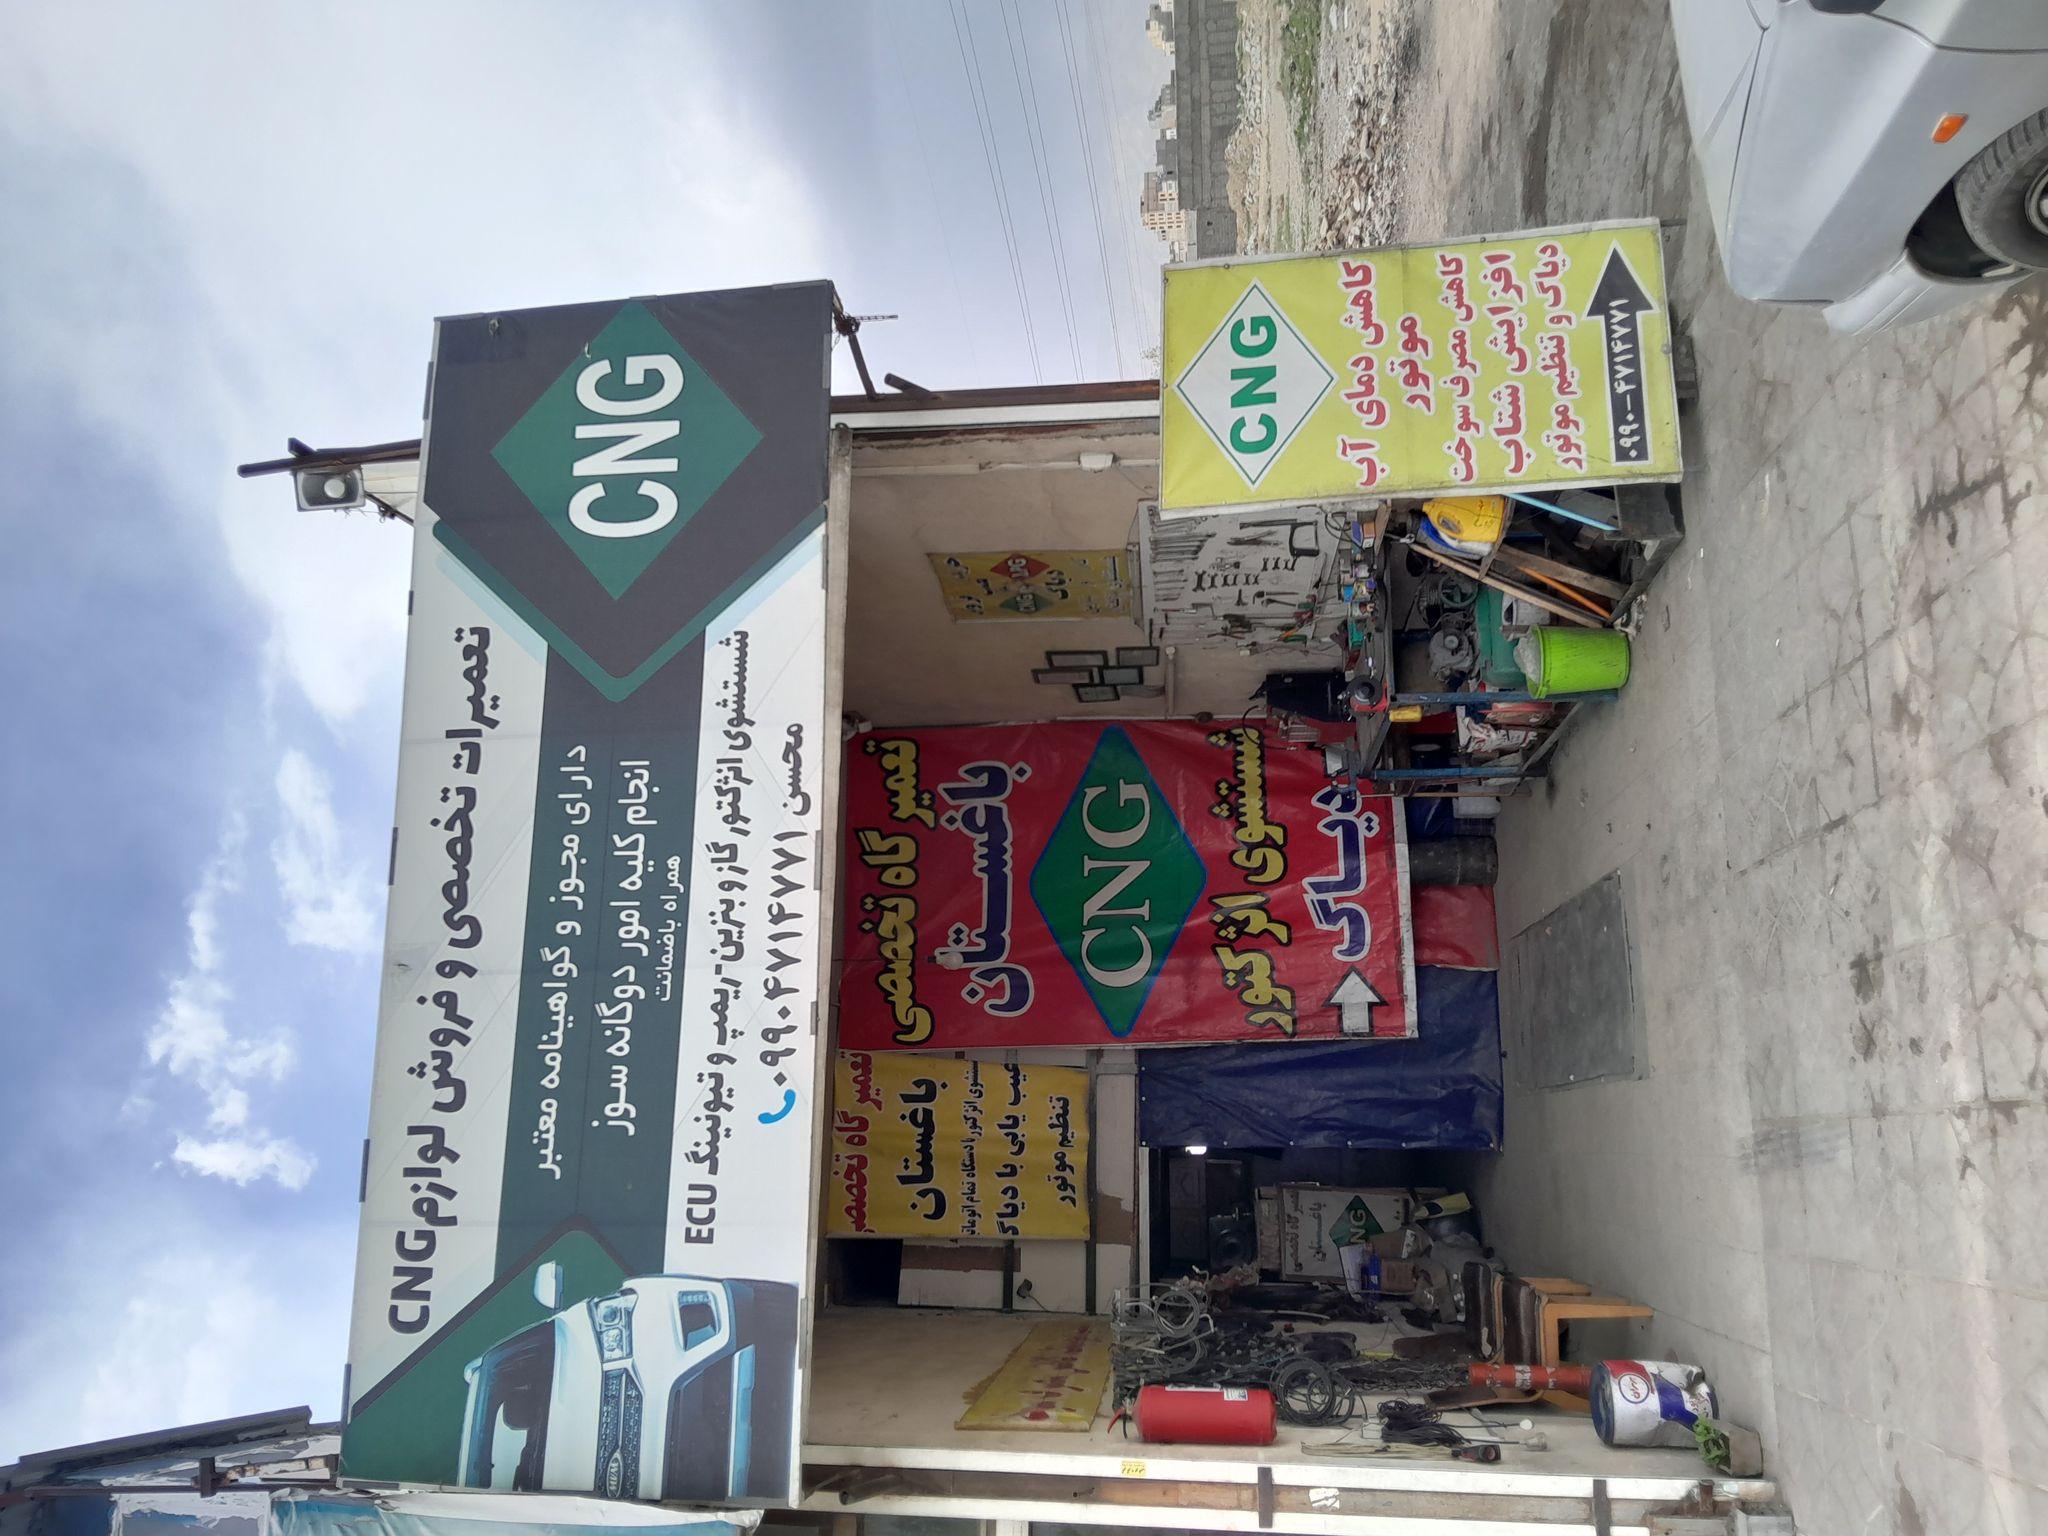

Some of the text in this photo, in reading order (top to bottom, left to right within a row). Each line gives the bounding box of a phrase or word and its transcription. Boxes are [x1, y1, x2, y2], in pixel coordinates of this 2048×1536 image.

[1229, 314, 1278, 455] CNG
[1341, 261, 1386, 486] کاهش دمای آب
[1388, 316, 1431, 413] موتور
[1439, 254, 1480, 482] کاهش مصرف سوخت
[1482, 253, 1531, 474] افزایش شتاب
[1535, 244, 1582, 470] دیاگ و تنظیم موتور
[567, 354, 684, 539] CNG
[444, 626, 499, 775] تعمیرات
[718, 631, 754, 750] شستشوی
[708, 842, 747, 874] گاز
[713, 757, 752, 836] انژکتور
[430, 787, 483, 949] تخصصی
[661, 856, 684, 910] همراه
[719, 879, 747, 893] و
[758, 723, 812, 1086] محسن ۰۹۹۰۴۷۱۴۷۷۱
[936, 761, 1034, 1016] باغستان
[1081, 778, 1152, 987] CNG
[1206, 727, 1295, 1035] شستشوی انژکتور
[1302, 782, 1380, 961] دیاگ
[435, 960, 477, 979] و
[531, 745, 592, 1179] دارای مجوز و گواهینامه معتبر
[592, 760, 659, 1136] انجام کلیه امور دوگانه سوز
[857, 894, 933, 1044] تخصصی
[406, 990, 474, 1112] فروش
[706, 1052, 736, 1066] و
[1001, 1063, 1026, 1106] عیب
[684, 1072, 731, 1175] تیونینگ
[896, 1079, 948, 1220] باغستان
[995, 1163, 1024, 1178] با
[997, 1115, 1026, 1156] یابی
[1047, 1096, 1076, 1208] تنظیم موتور
[685, 1184, 718, 1244] ECU
[1350, 1208, 1366, 1243] NG
